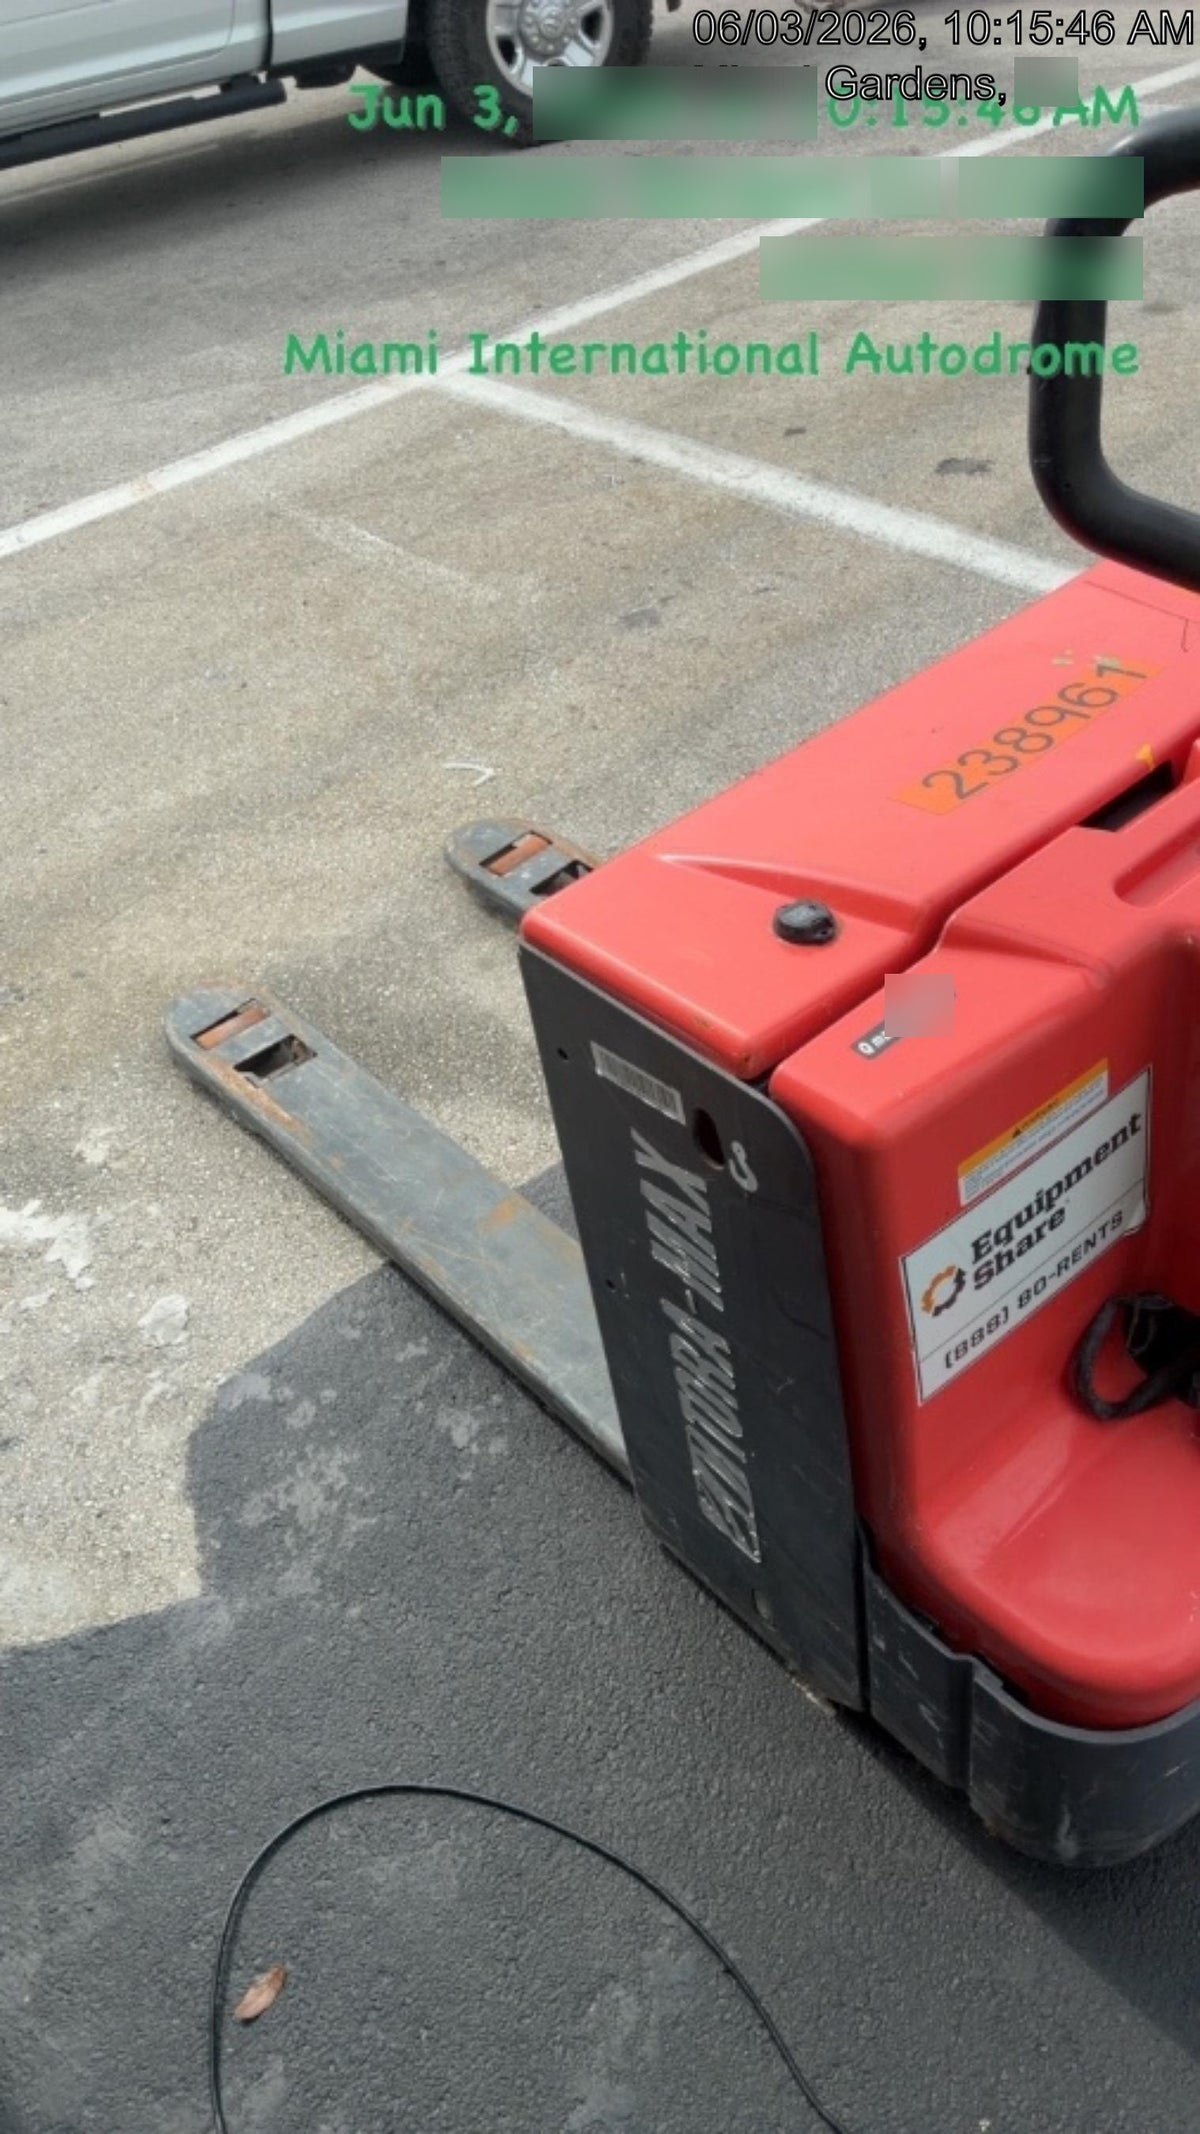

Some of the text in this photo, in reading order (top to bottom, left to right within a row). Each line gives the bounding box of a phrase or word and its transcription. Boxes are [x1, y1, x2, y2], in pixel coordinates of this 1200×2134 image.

[921, 663, 1148, 800] 238961
[971, 1113, 1142, 1265] Equipment
[973, 1207, 1066, 1291] Share
[944, 1305, 1009, 1369] (888)
